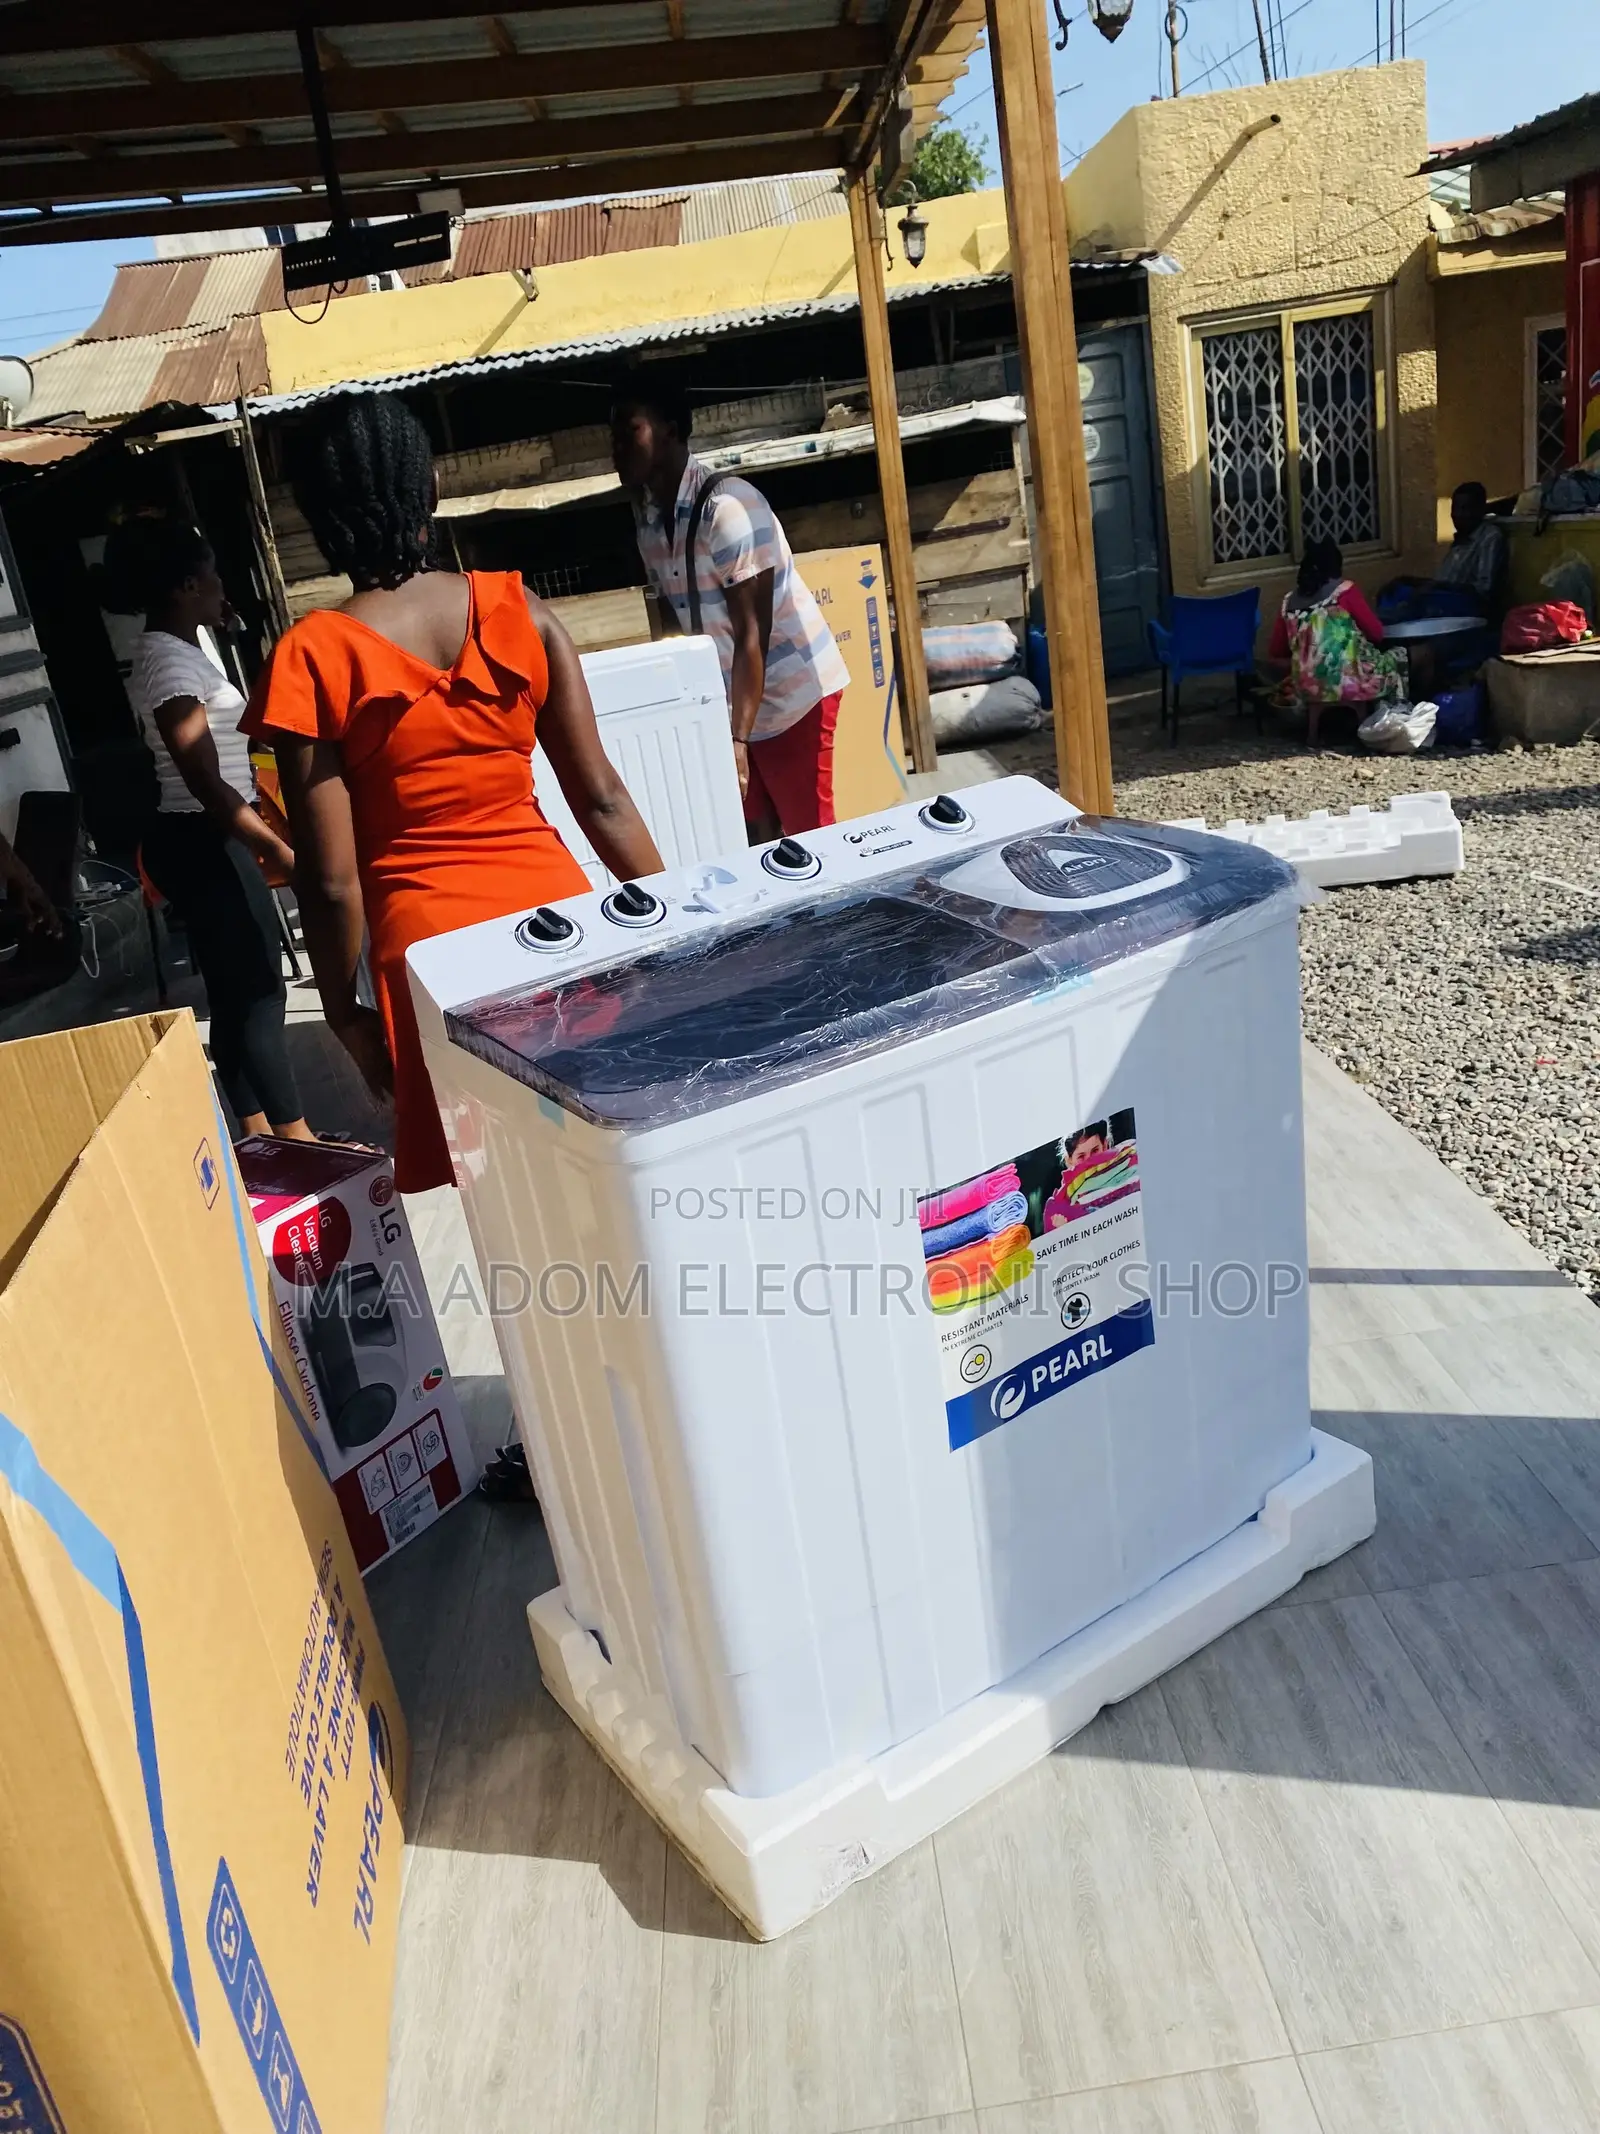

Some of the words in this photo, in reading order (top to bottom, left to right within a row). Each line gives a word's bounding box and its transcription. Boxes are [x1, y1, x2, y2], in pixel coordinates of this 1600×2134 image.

[860, 825, 896, 839] PEARL
[1064, 863, 1084, 873] Air
[1082, 857, 1107, 867] Dry
[303, 1215, 324, 1271] Vacuum
[318, 1207, 332, 1229] LG
[378, 1206, 402, 1245] LG
[1036, 1243, 1058, 1261] SAVE
[1058, 1233, 1079, 1249] TIME
[1080, 1228, 1091, 1240] IN
[1092, 1217, 1113, 1235] EACH
[1114, 1205, 1139, 1223] WASH
[287, 1225, 308, 1276] Cleaner
[1052, 1265, 1085, 1288] PROTECT
[1086, 1255, 1109, 1272] YOUR
[1109, 1239, 1141, 1261] CLOTHES
[1083, 1271, 1101, 1284] WASH
[941, 1316, 985, 1344] RESISTANT
[986, 1293, 1029, 1323] MATERIALS
[942, 1345, 950, 1353] IN
[950, 1332, 976, 1350] EXTREME
[976, 1320, 1004, 1338] CLIMATES
[1032, 1334, 1113, 1393] PEARL
[285, 1539, 333, 1783] SEMI-AUTOMATIQUE
[313, 1596, 339, 1719] DOUBLE
[327, 1607, 356, 1753] MACHINE
[300, 1711, 320, 1811] CUVE
[306, 1775, 330, 1909] LAVER
[353, 1768, 384, 1946] PEARL
